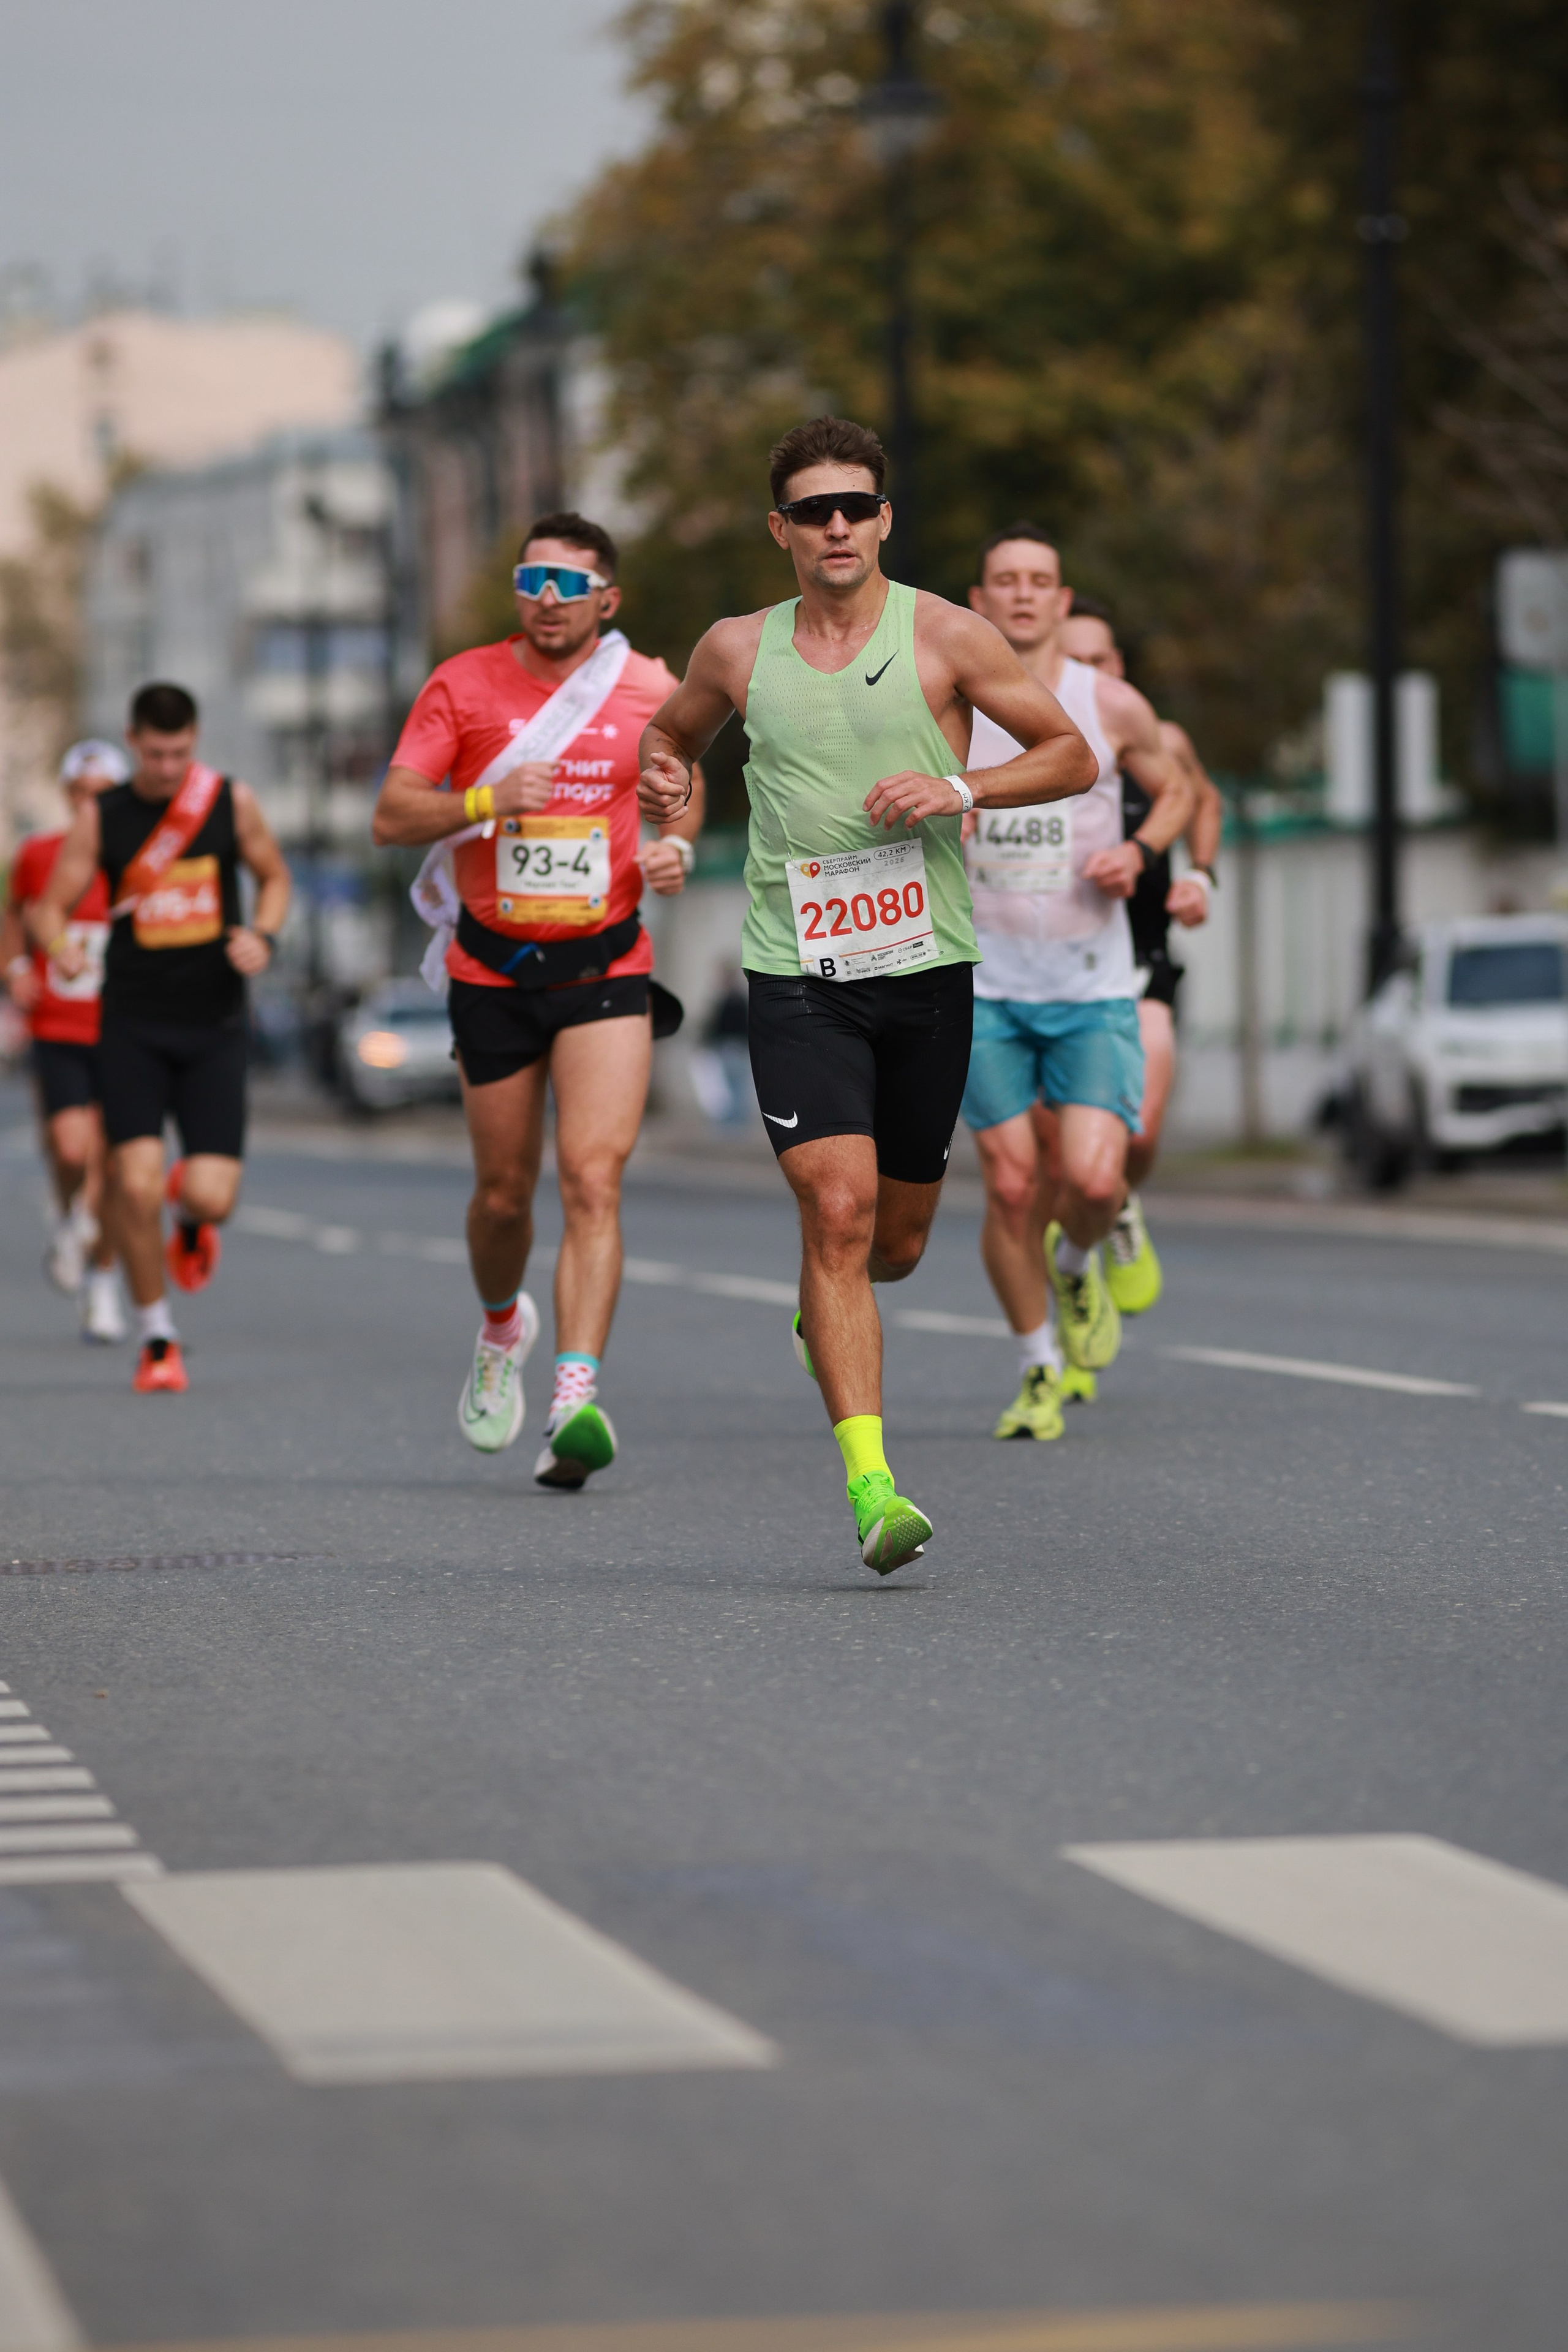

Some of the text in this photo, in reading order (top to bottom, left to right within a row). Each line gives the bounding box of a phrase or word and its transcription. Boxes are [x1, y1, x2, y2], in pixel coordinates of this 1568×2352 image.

[512, 845, 591, 876] 93-4
[823, 855, 858, 864] СБЕРПРАЙМ
[823, 857, 871, 870] МОСКОВСКИЙ
[824, 866, 859, 876] МАРАФОН
[800, 881, 924, 941] 22080
